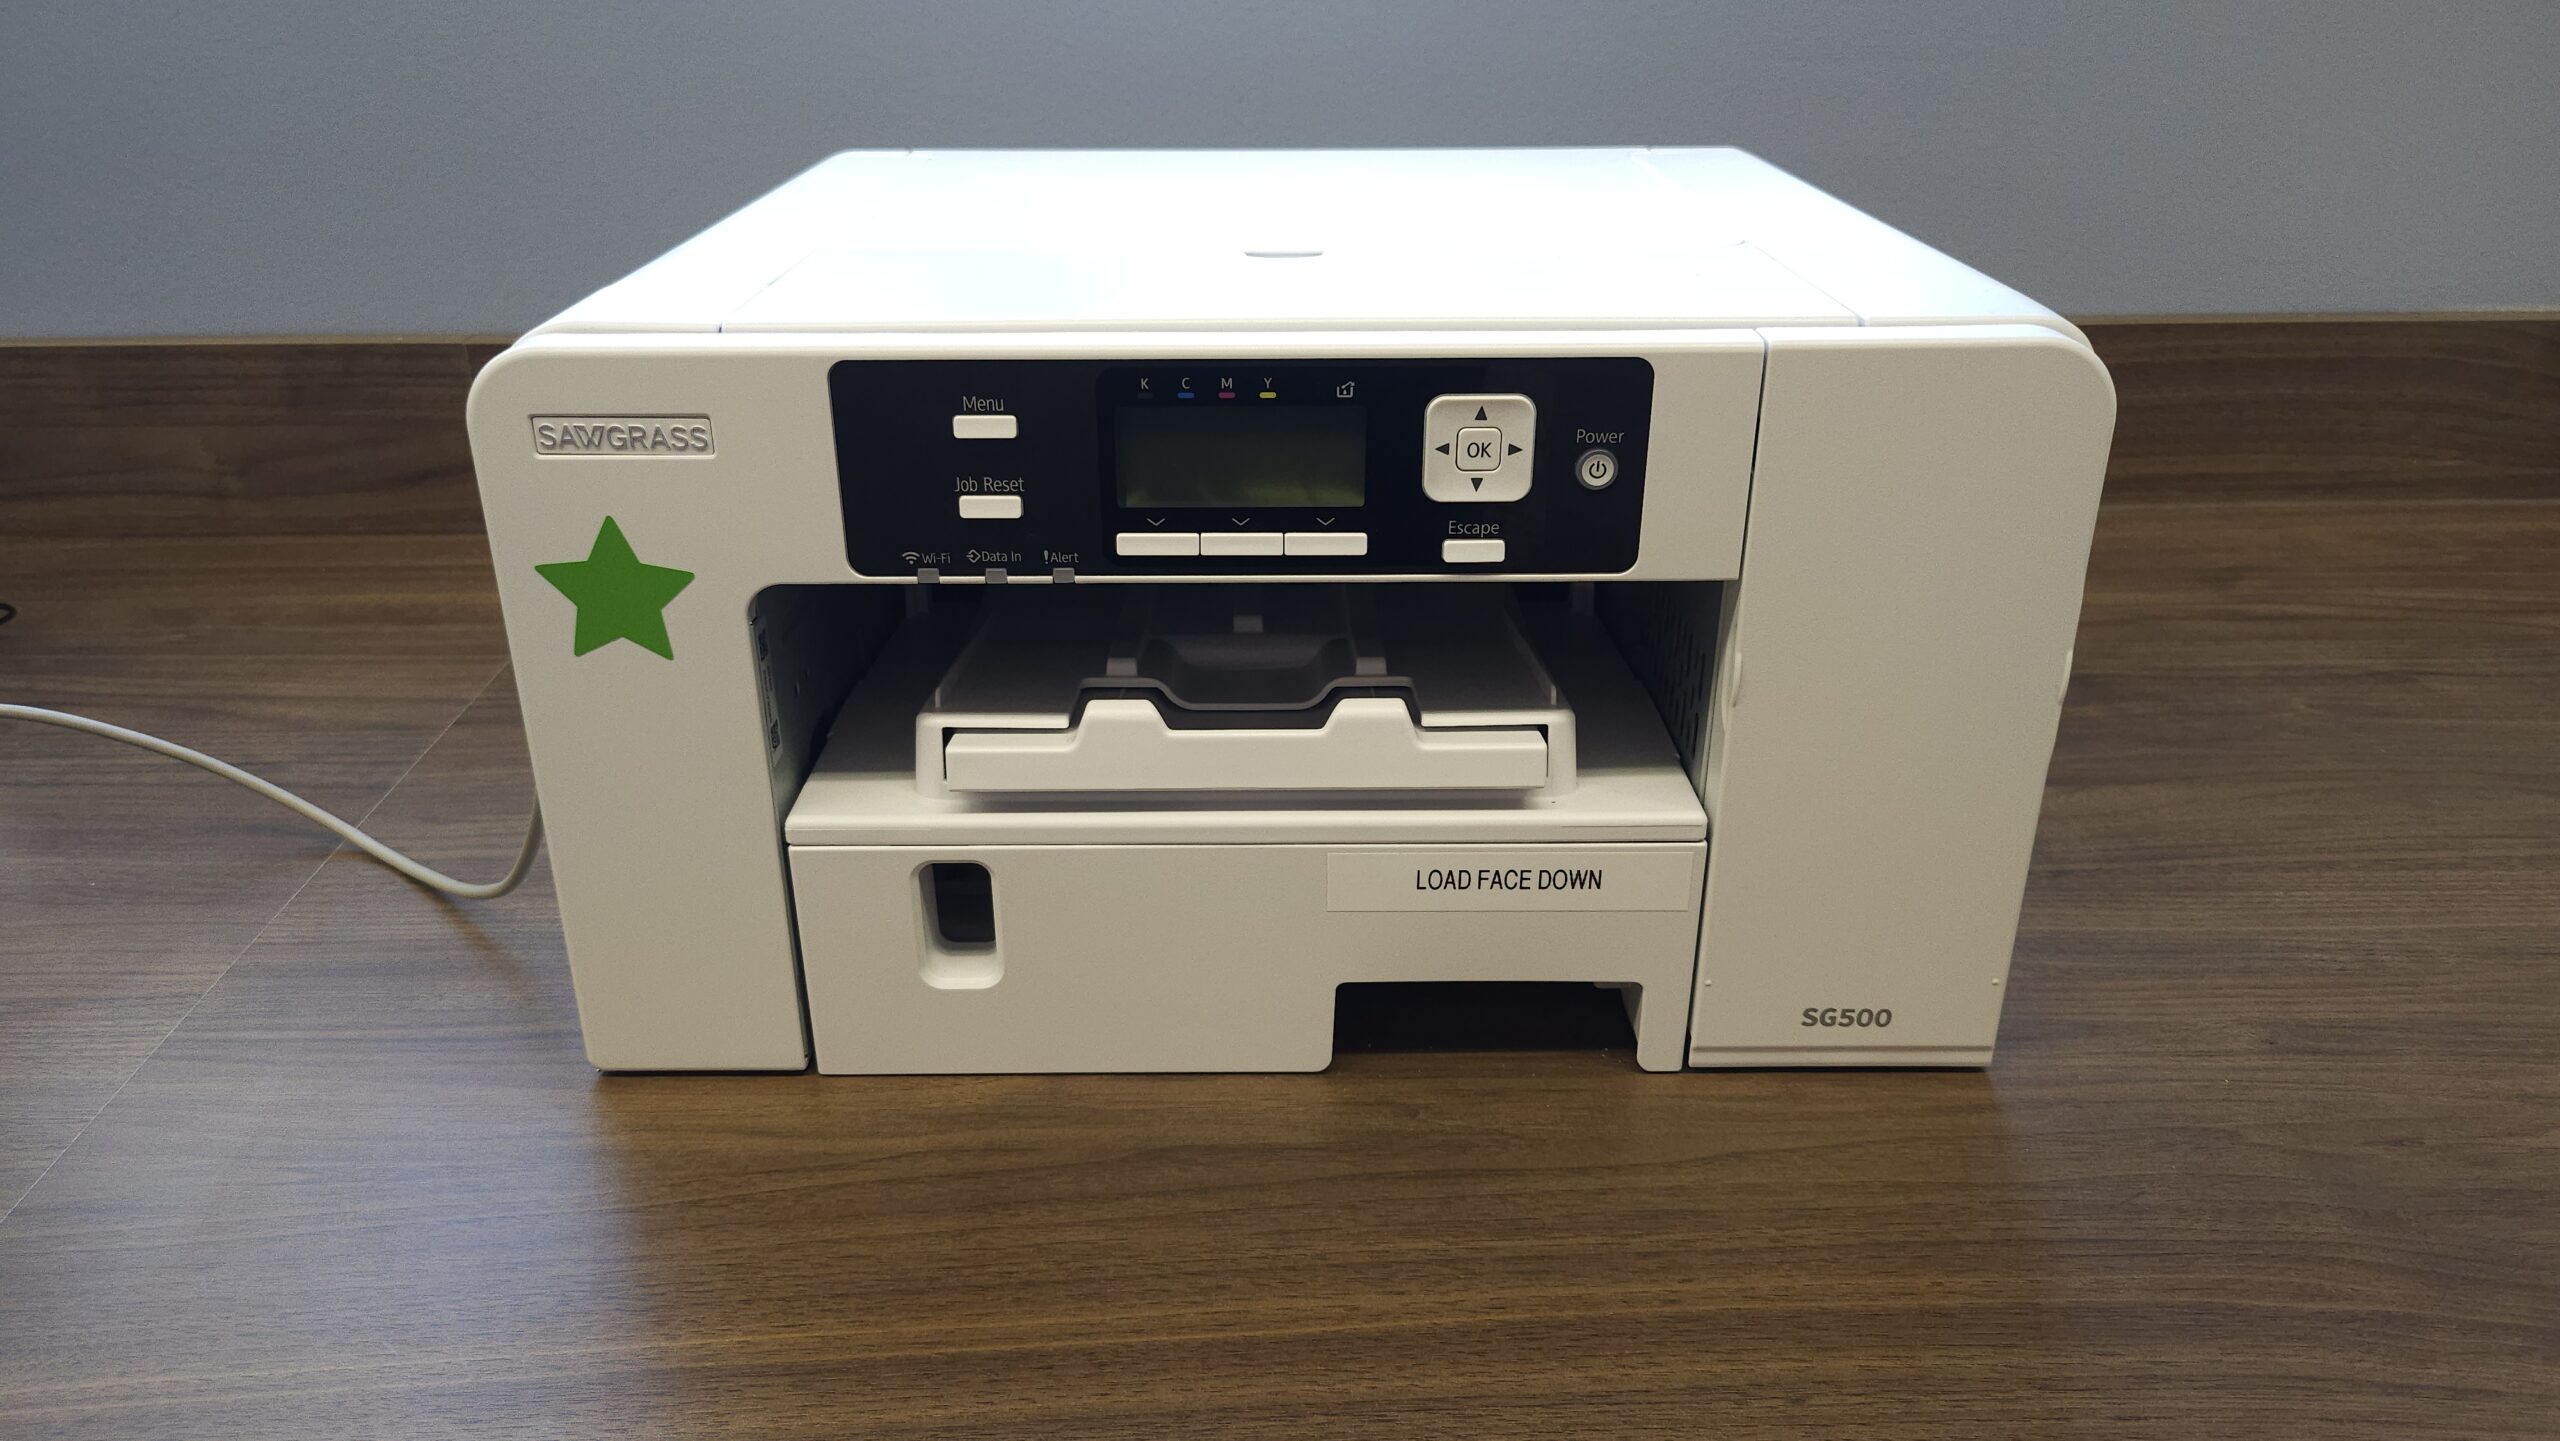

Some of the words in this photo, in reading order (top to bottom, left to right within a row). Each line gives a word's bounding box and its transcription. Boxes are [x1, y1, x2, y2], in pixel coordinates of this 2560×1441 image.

[1140, 377, 1149, 390] K
[1181, 377, 1190, 389] C
[1221, 377, 1233, 389] M
[1263, 377, 1272, 389] Y
[962, 396, 1004, 412] Menu
[538, 424, 708, 450] SAWGRASS
[1576, 428, 1624, 445] Power
[1467, 442, 1491, 458] OK
[954, 477, 978, 492] Job
[983, 477, 1025, 492] Reset
[1448, 521, 1500, 538] Escape
[922, 552, 950, 564] Wi-Fi
[982, 551, 1007, 562] Data
[1012, 551, 1021, 562] In
[1416, 869, 1471, 890] LOAD
[1477, 869, 1531, 890] FACE
[1538, 869, 1602, 890] DOWN
[1801, 1007, 1892, 1028] SG500
